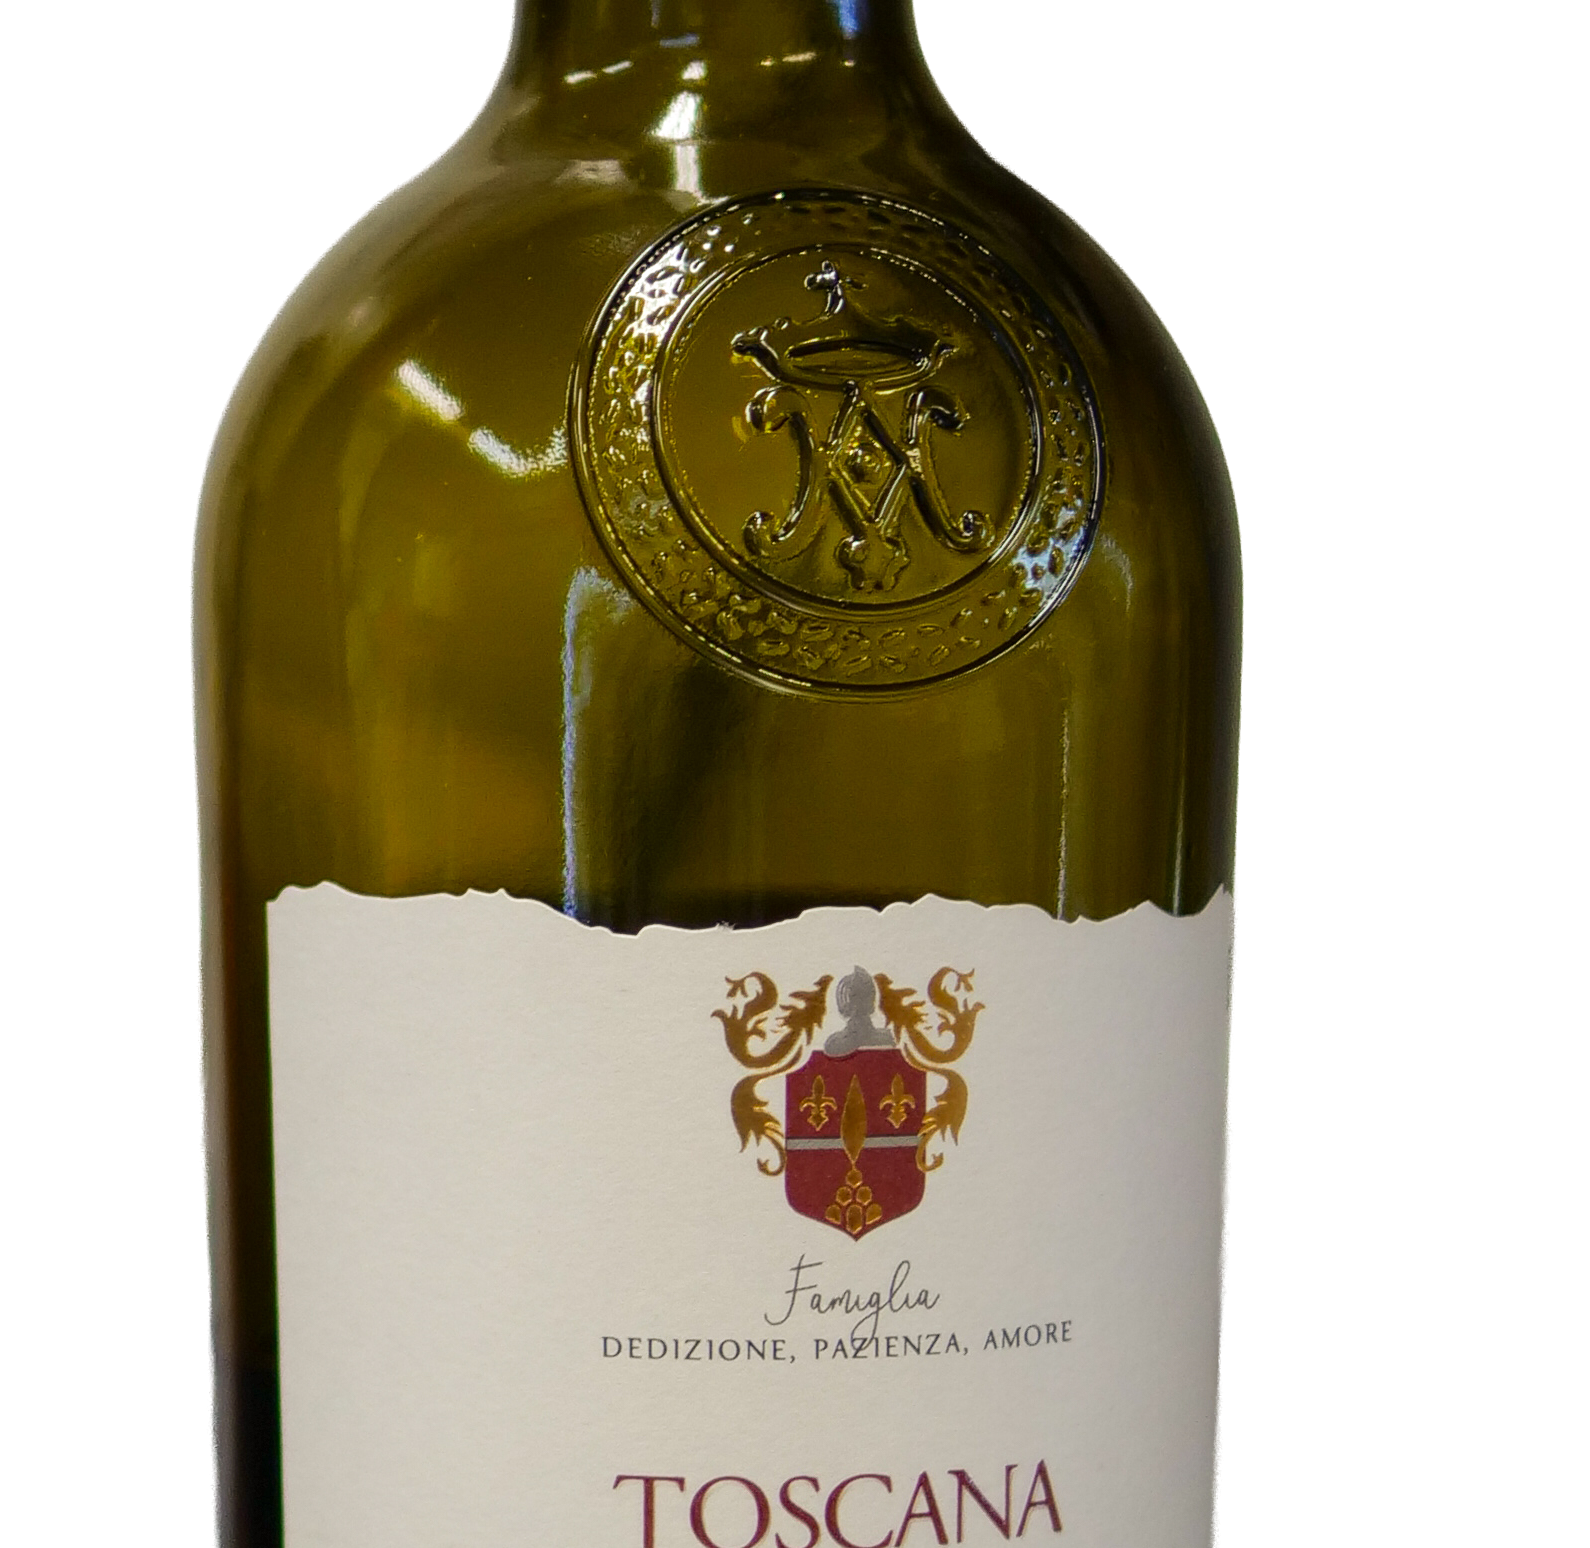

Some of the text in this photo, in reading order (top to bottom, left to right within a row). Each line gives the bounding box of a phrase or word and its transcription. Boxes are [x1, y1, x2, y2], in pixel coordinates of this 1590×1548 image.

[601, 1319, 1074, 1364] DEDIZIONE, PAZIENZA, AMORE
[764, 1254, 941, 1356] Famiglia
